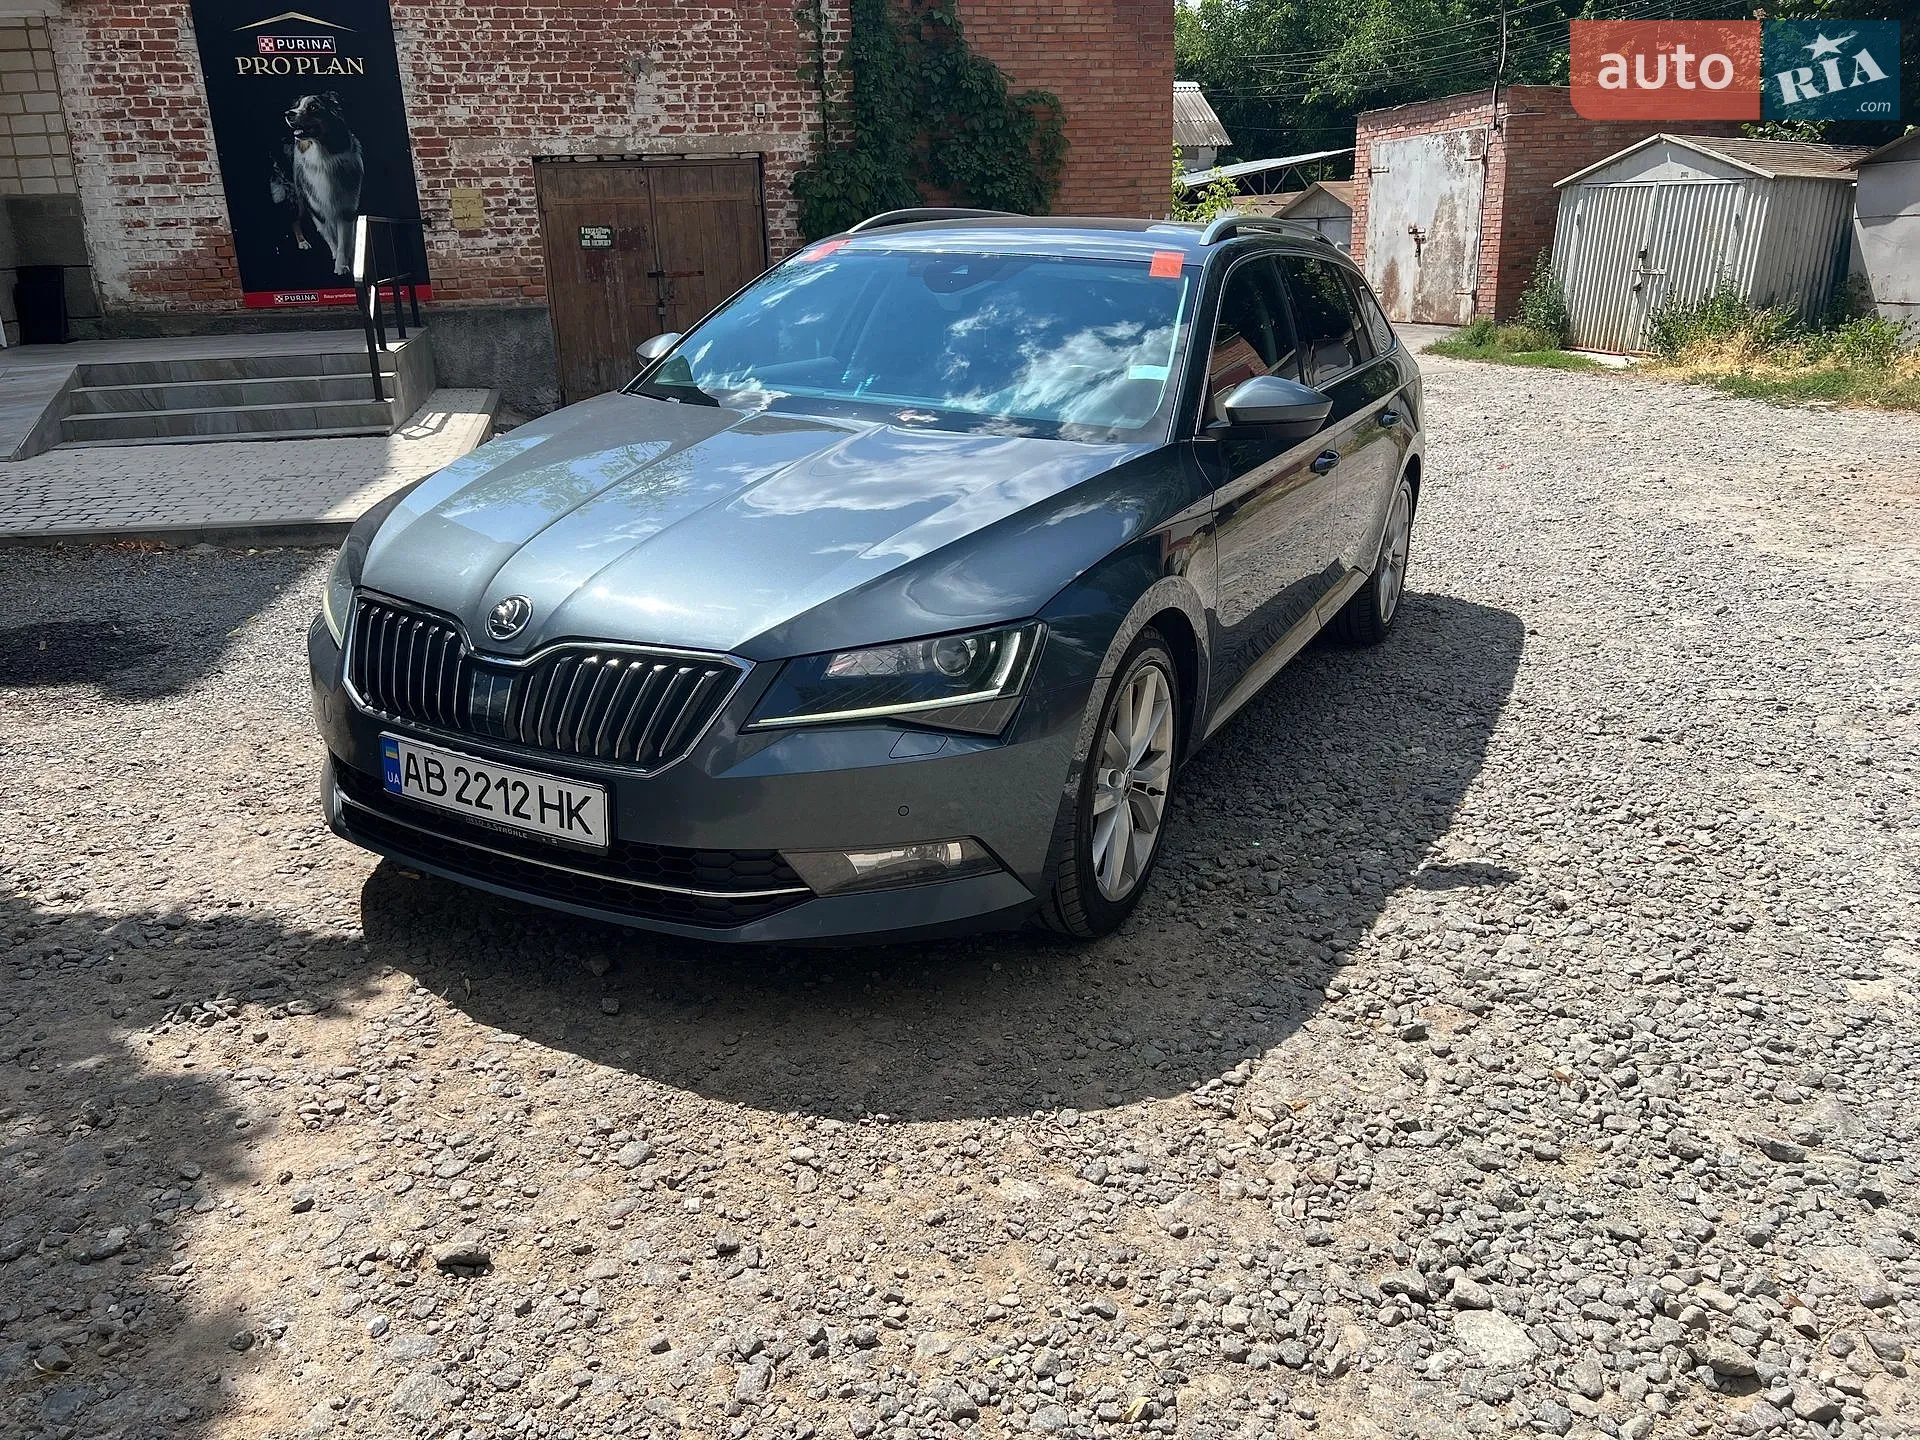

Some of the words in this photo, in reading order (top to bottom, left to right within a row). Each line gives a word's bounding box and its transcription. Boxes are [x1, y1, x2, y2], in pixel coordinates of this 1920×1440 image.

[276, 39, 331, 50] PURINA
[235, 57, 291, 75] PRO
[295, 57, 364, 75] PLAN
[284, 294, 317, 302] PURINA
[387, 771, 400, 785] UA
[404, 752, 447, 796] AB
[454, 766, 531, 820] 2212
[538, 785, 593, 835] HK
